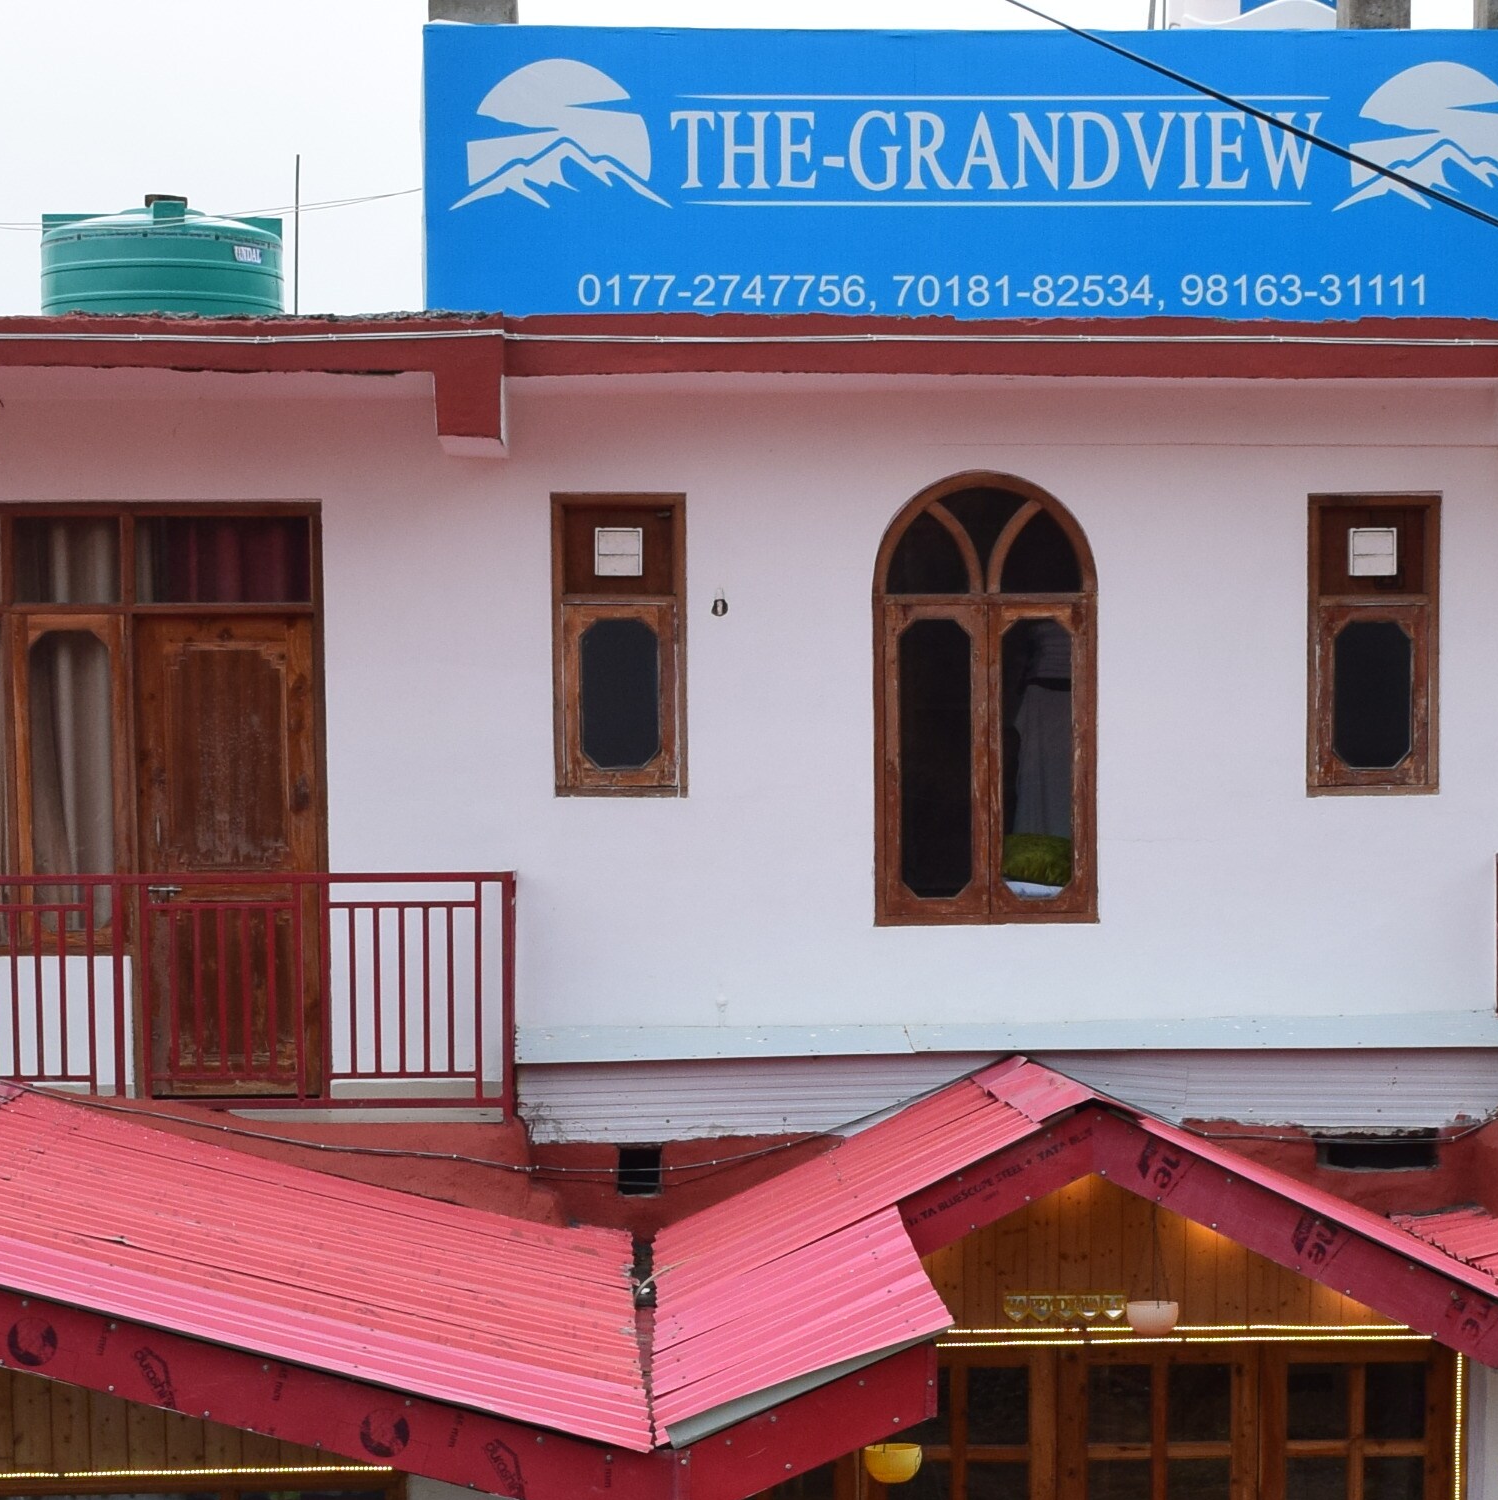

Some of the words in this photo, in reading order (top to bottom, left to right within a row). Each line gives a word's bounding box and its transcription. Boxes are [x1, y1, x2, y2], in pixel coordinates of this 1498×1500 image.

[669, 109, 1324, 193] THE-GRANDVIEW
[577, 274, 876, 313] 0177-2747756,
[893, 274, 1165, 313] 70181-82534,
[1181, 274, 1426, 309] 98163-31111
